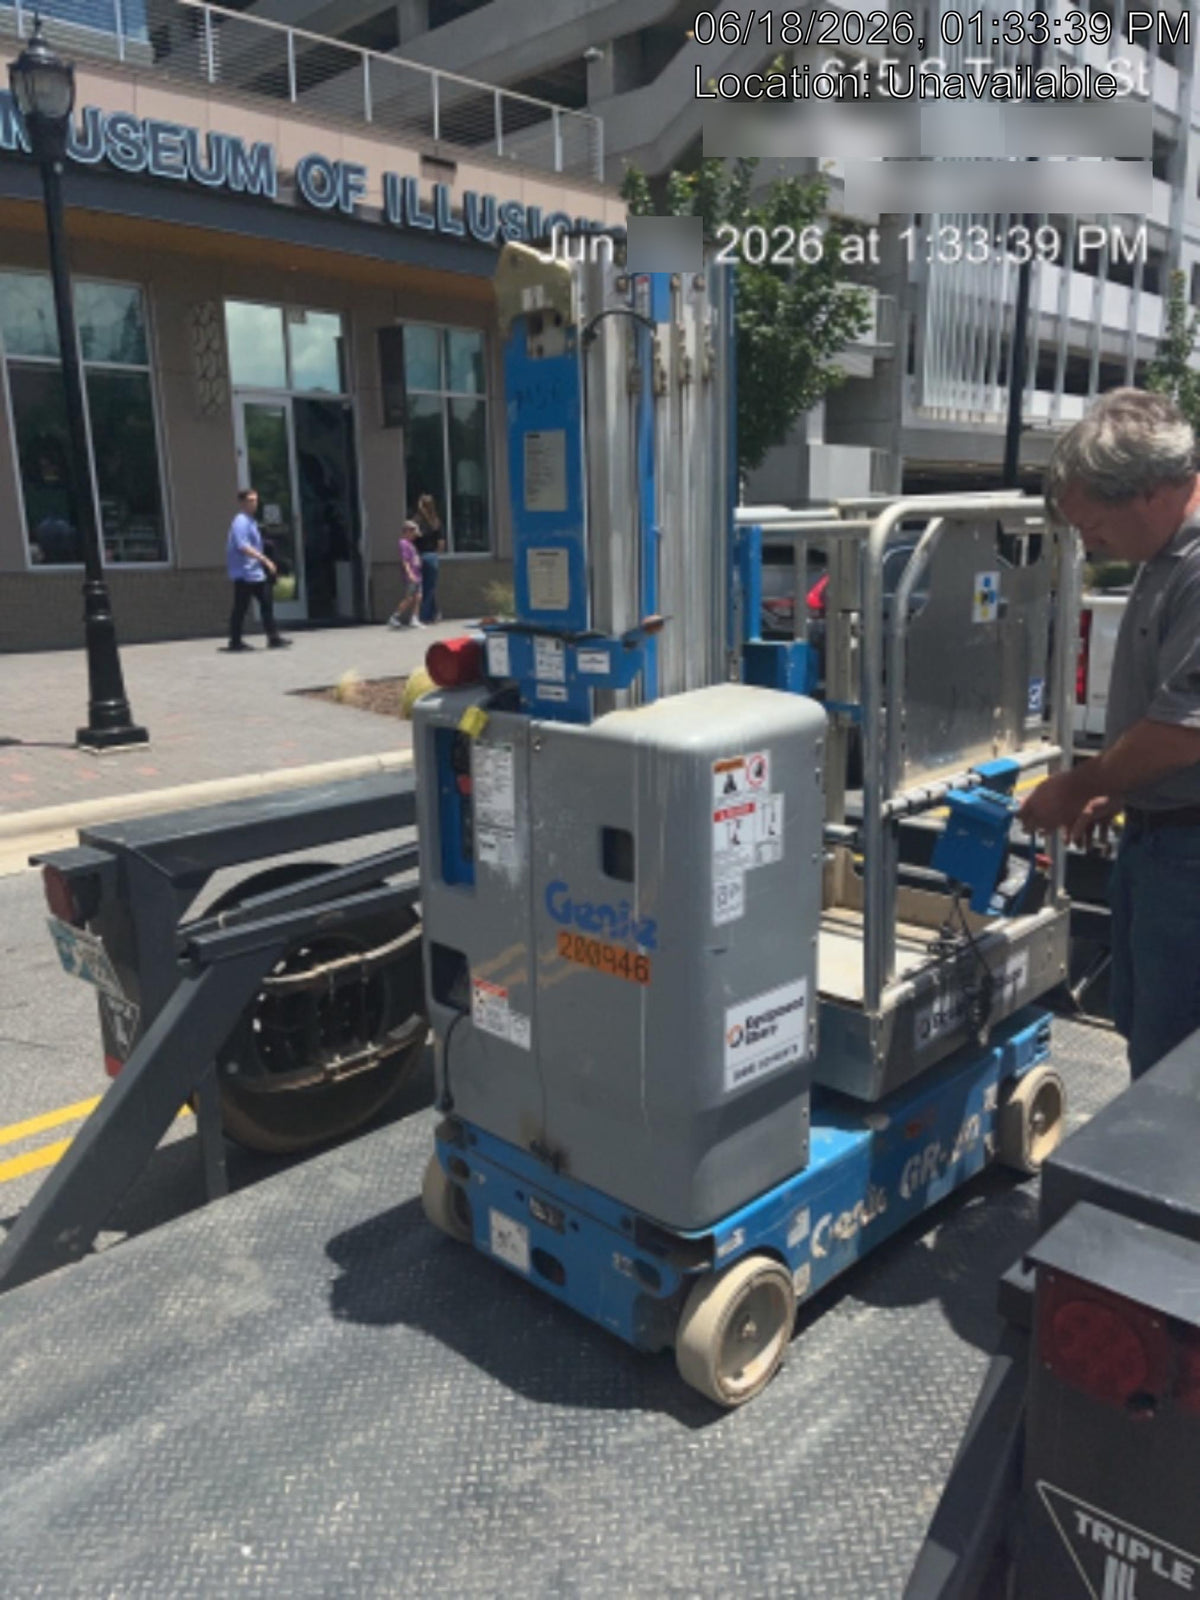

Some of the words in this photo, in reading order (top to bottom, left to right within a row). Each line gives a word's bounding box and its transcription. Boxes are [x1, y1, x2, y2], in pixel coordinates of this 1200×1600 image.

[297, 152, 366, 213] OF
[382, 170, 627, 243] ILLUSIO
[1074, 1509, 1195, 1592] TRIPLE
